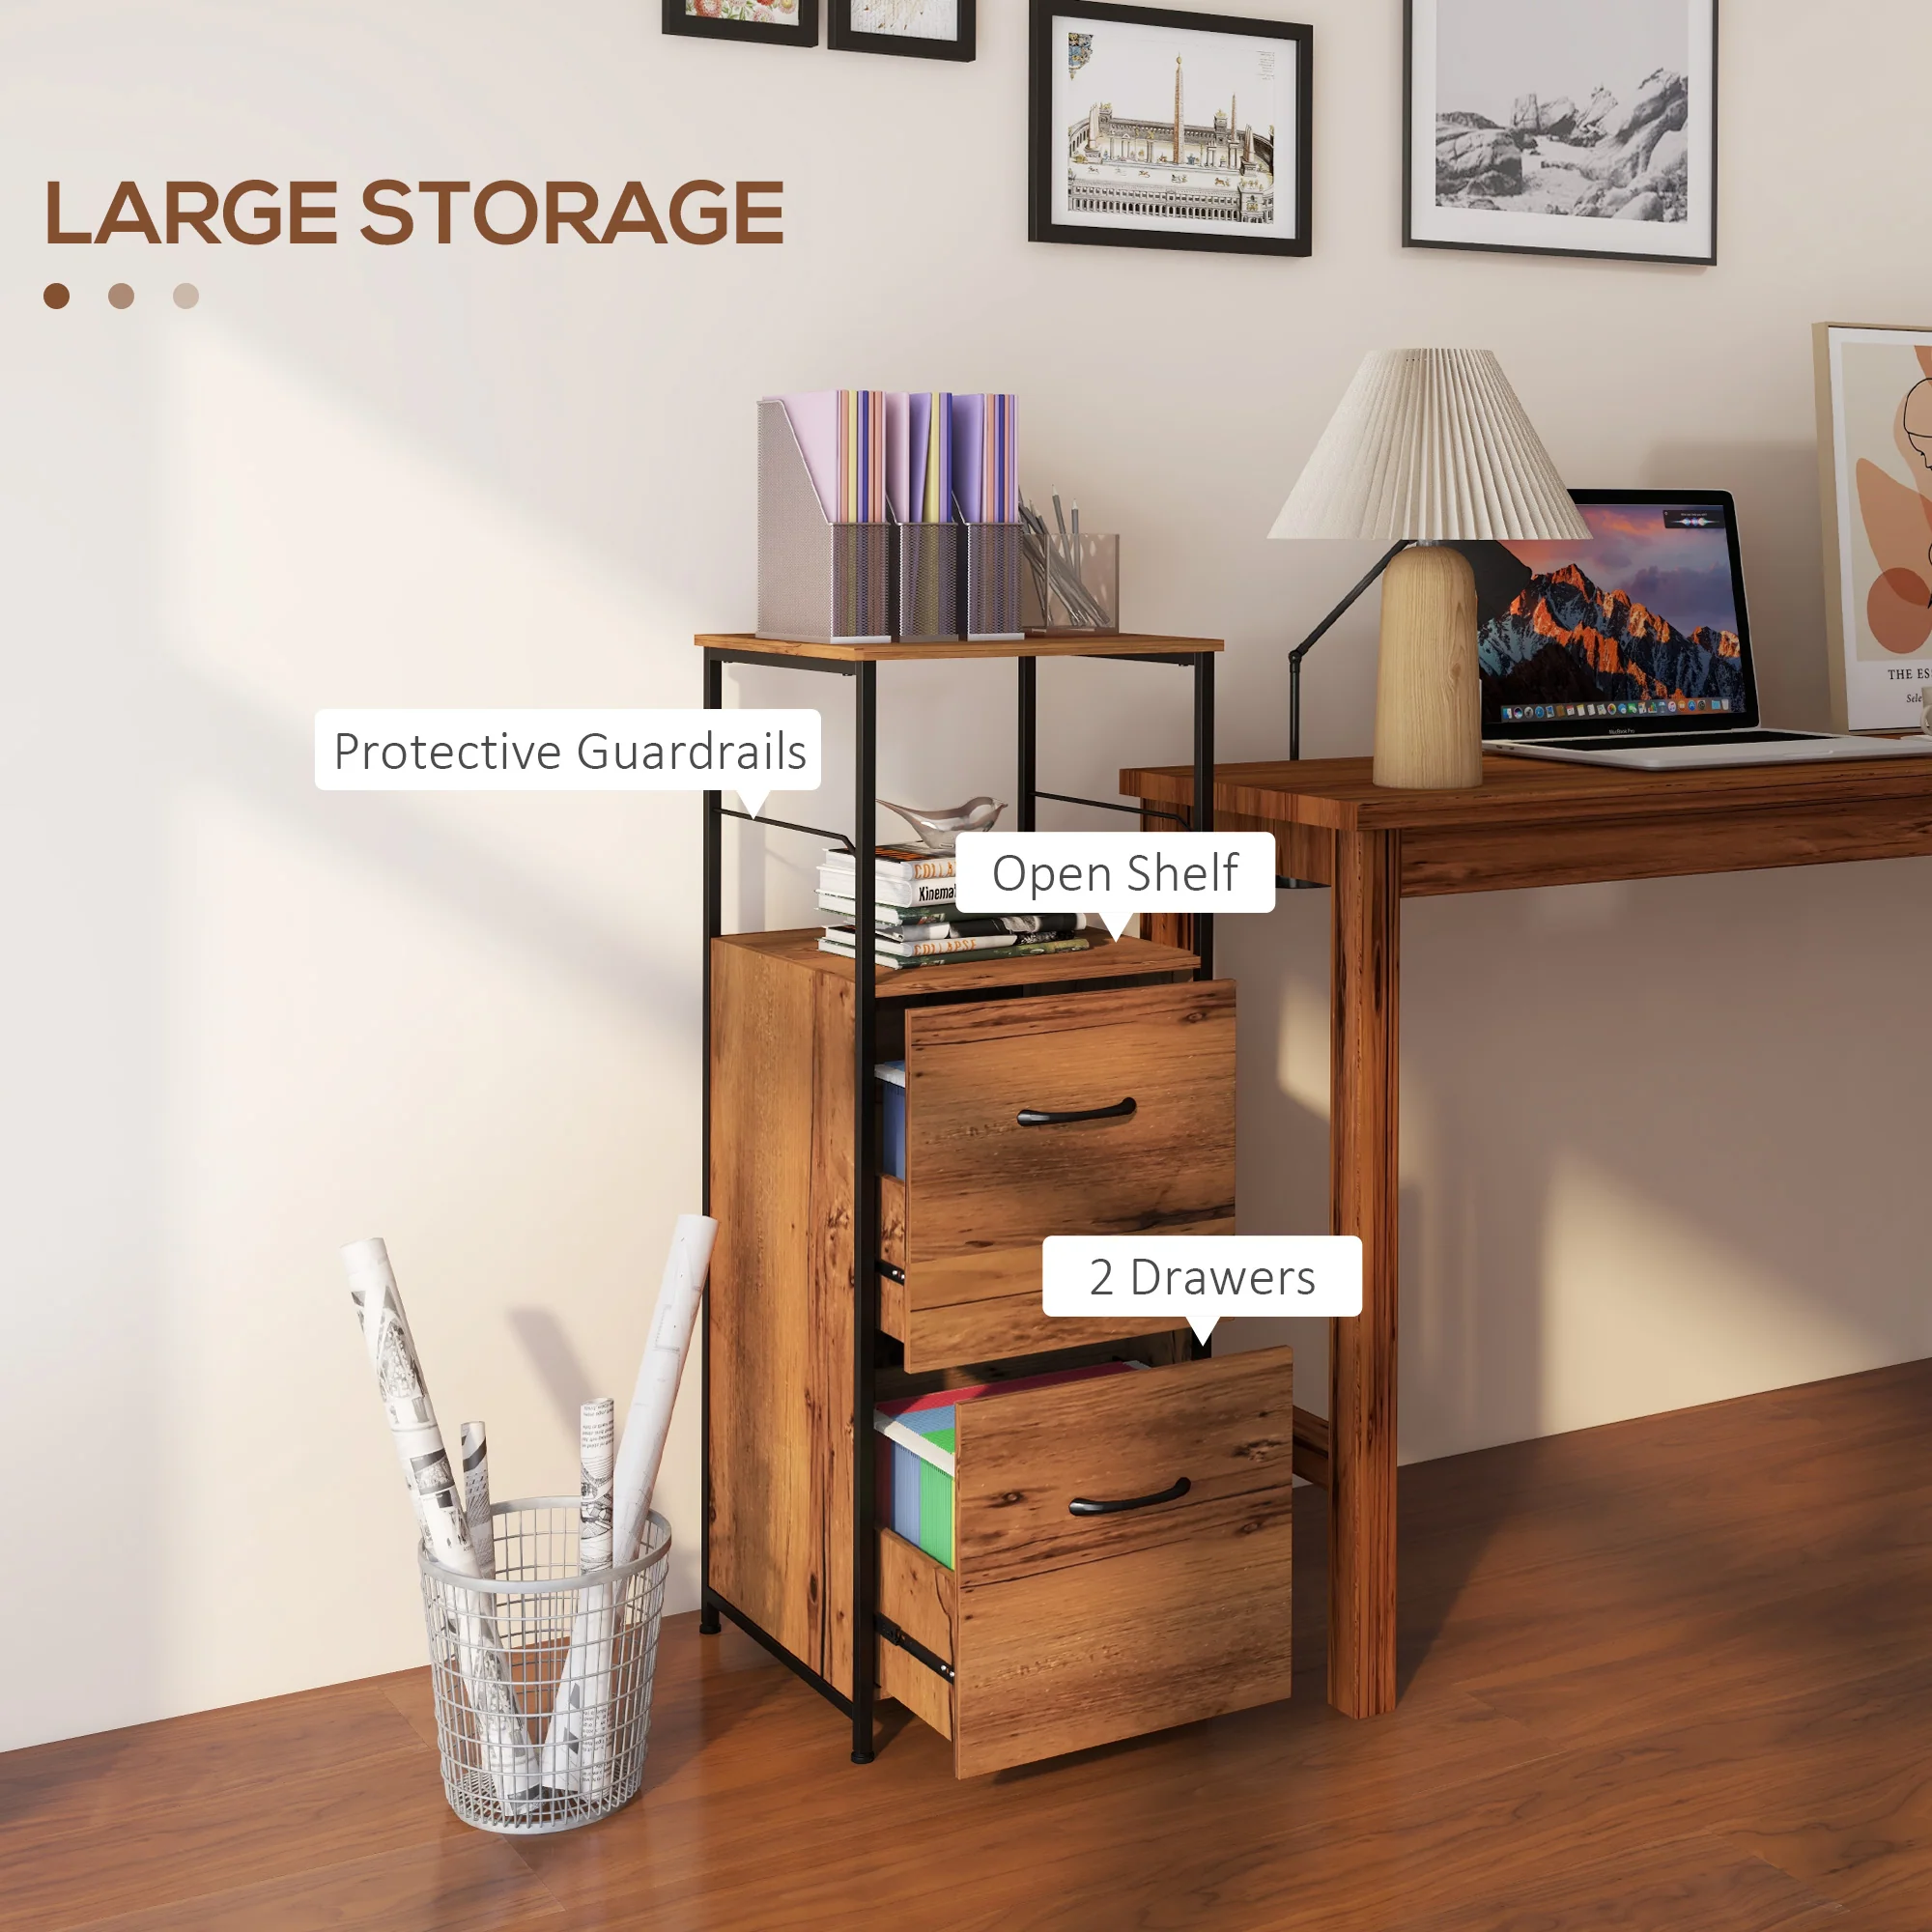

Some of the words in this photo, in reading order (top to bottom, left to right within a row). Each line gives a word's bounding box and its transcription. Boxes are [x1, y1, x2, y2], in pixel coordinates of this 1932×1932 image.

[1887, 668, 1914, 680] THE
[1917, 668, 1932, 679] ES
[914, 861, 956, 879] COLLA
[913, 938, 977, 956] COLLAPSE
